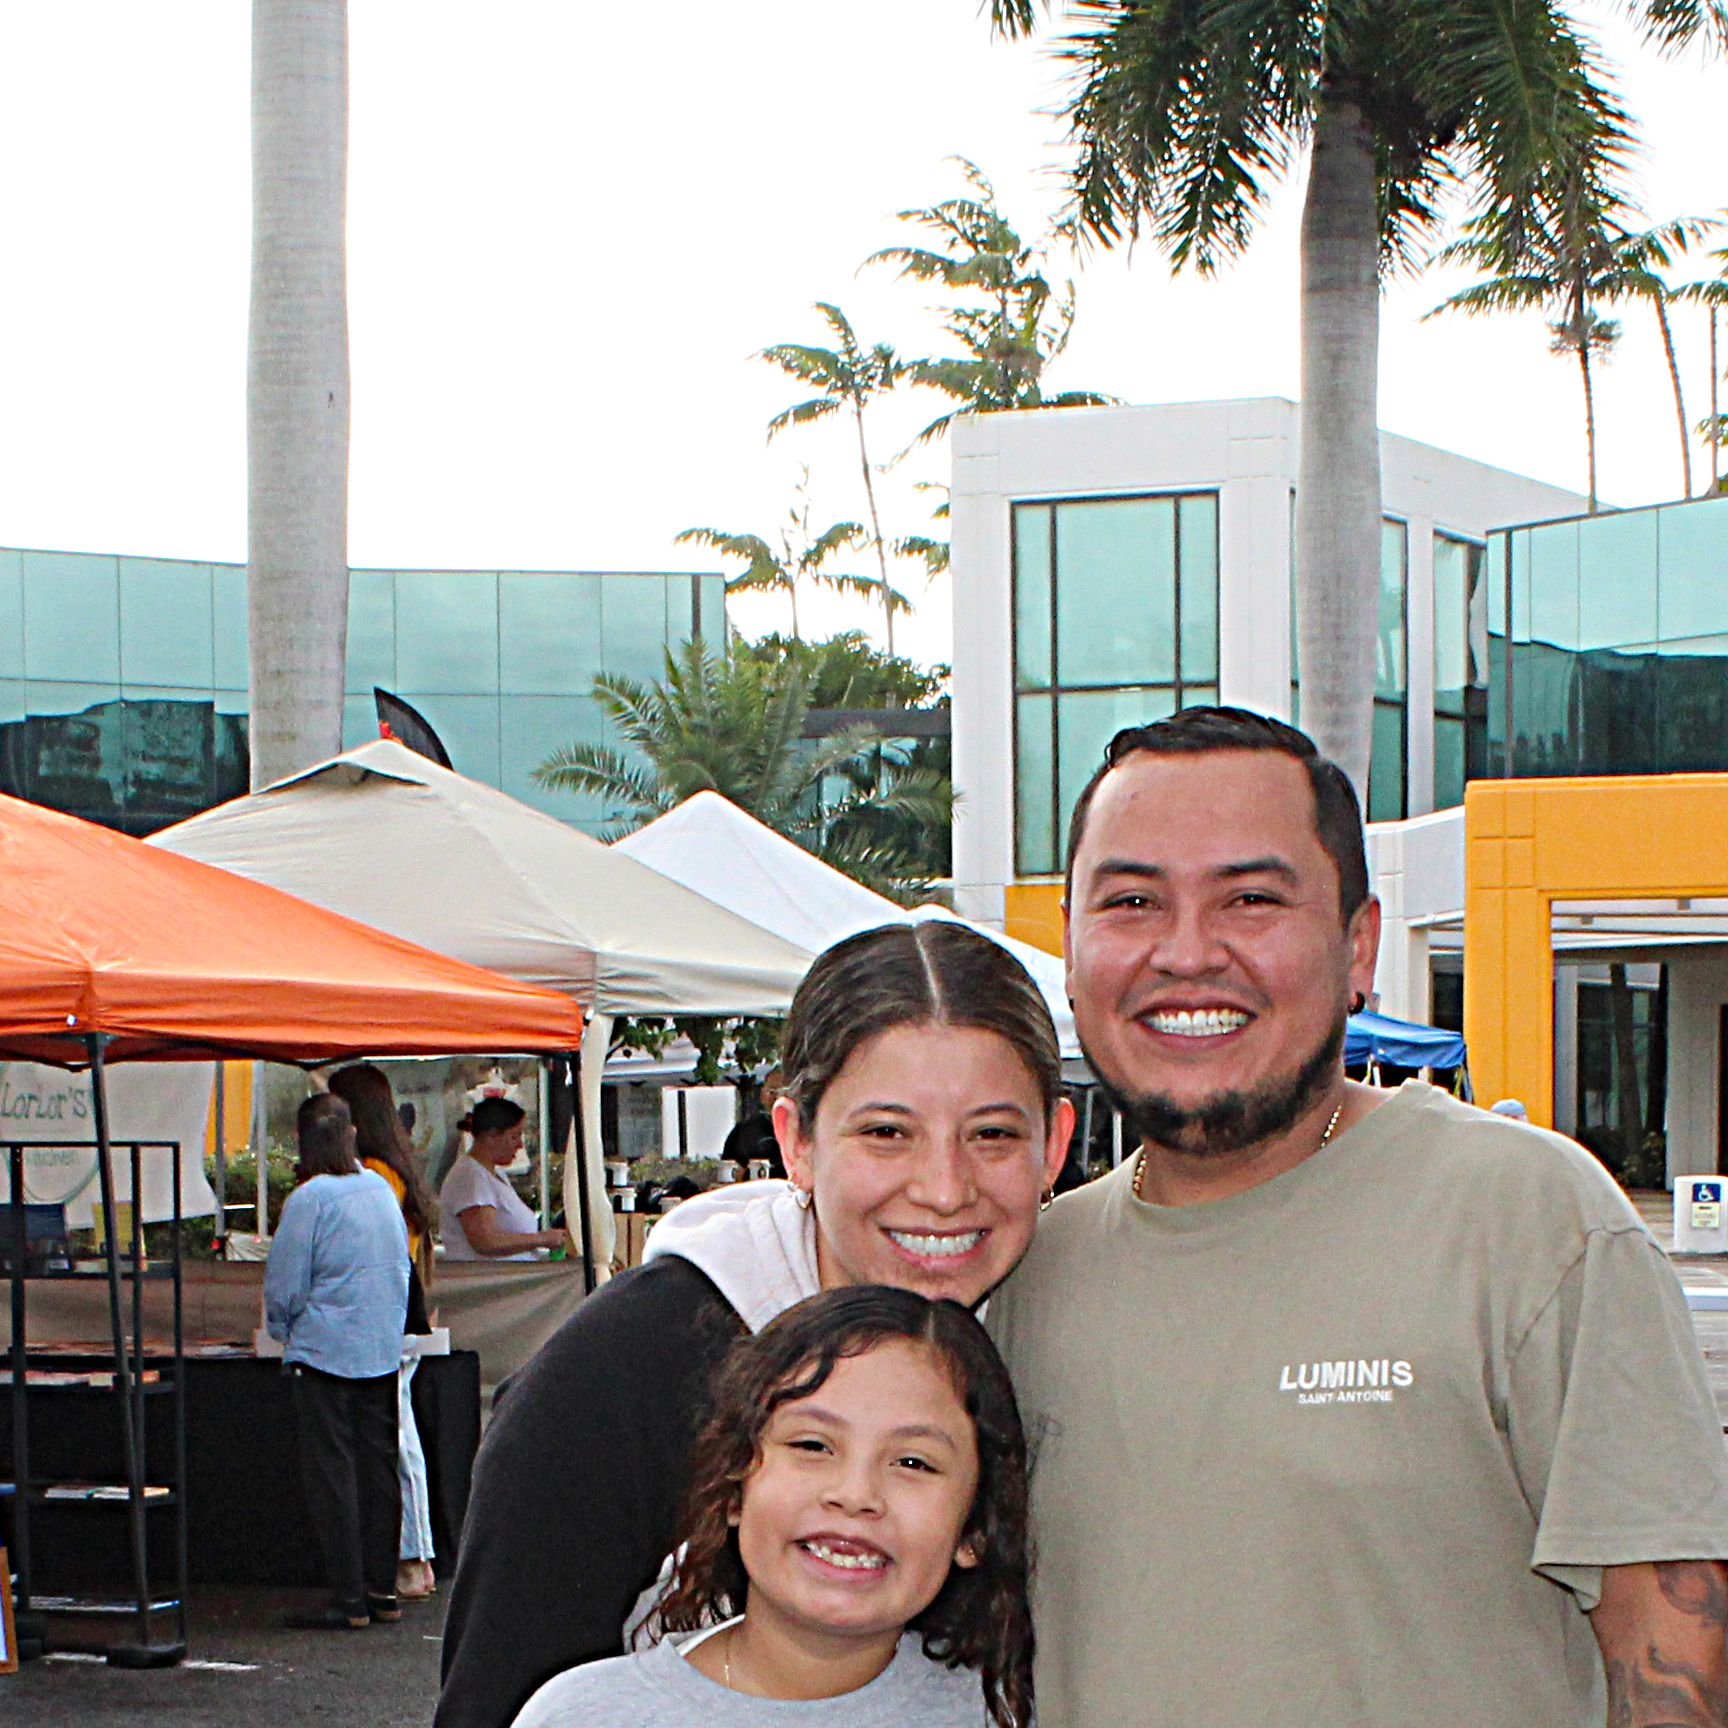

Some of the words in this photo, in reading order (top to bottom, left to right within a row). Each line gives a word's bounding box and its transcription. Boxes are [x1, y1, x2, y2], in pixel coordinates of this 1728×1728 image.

[1278, 1359, 1414, 1391] LUMINIS
[1298, 1393, 1333, 1404] SAINT
[1337, 1389, 1394, 1403] ANTOINE
